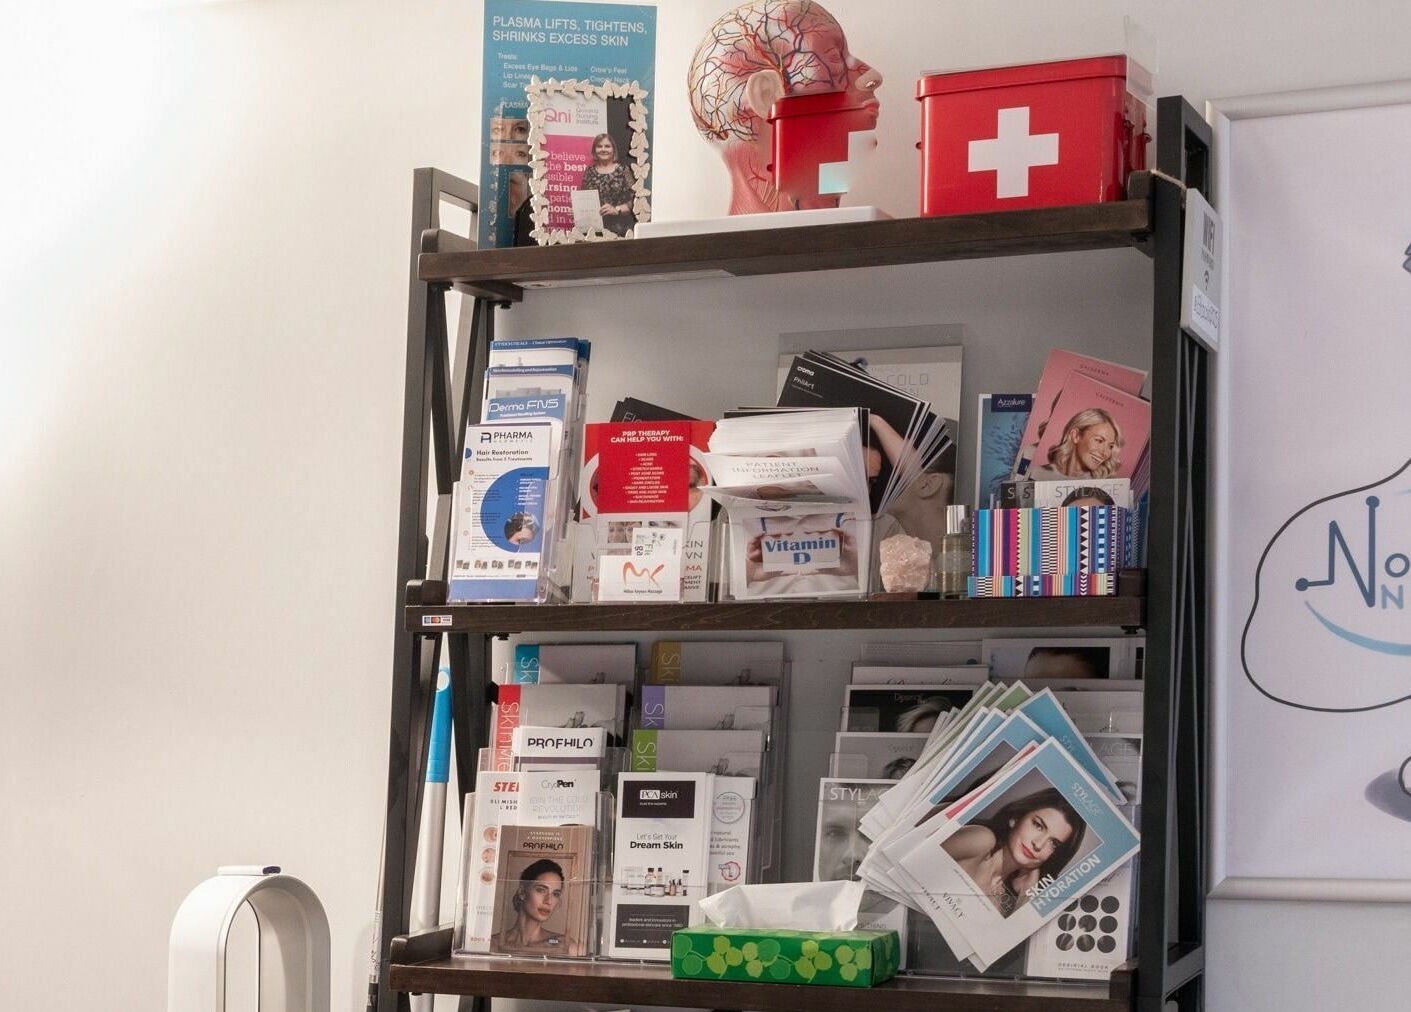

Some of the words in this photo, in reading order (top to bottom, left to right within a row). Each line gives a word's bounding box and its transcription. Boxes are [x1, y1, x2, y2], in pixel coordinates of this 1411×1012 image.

[493, 16, 541, 29] PLASMA
[545, 18, 580, 32] LIFTS,
[584, 20, 647, 34] TIGHTENS,
[493, 30, 545, 43] SHRINKS
[550, 32, 597, 45] EXCESS
[601, 35, 629, 47] SKIN
[552, 151, 586, 161] believe
[797, 366, 815, 377] croma
[997, 398, 1026, 407] Azzalure
[493, 432, 533, 440] PHARMA
[1055, 483, 1120, 498] STYLAGE
[765, 537, 836, 553] Vitamin
[793, 552, 811, 565] D
[640, 790, 659, 799] PCA
[660, 790, 678, 799] skin
[652, 833, 663, 841] Get
[664, 833, 678, 841] Your
[630, 841, 661, 850] Dream
[663, 841, 683, 850] Skin
[1026, 874, 1055, 899] SKIN
[1033, 854, 1102, 910] HYDRATION
